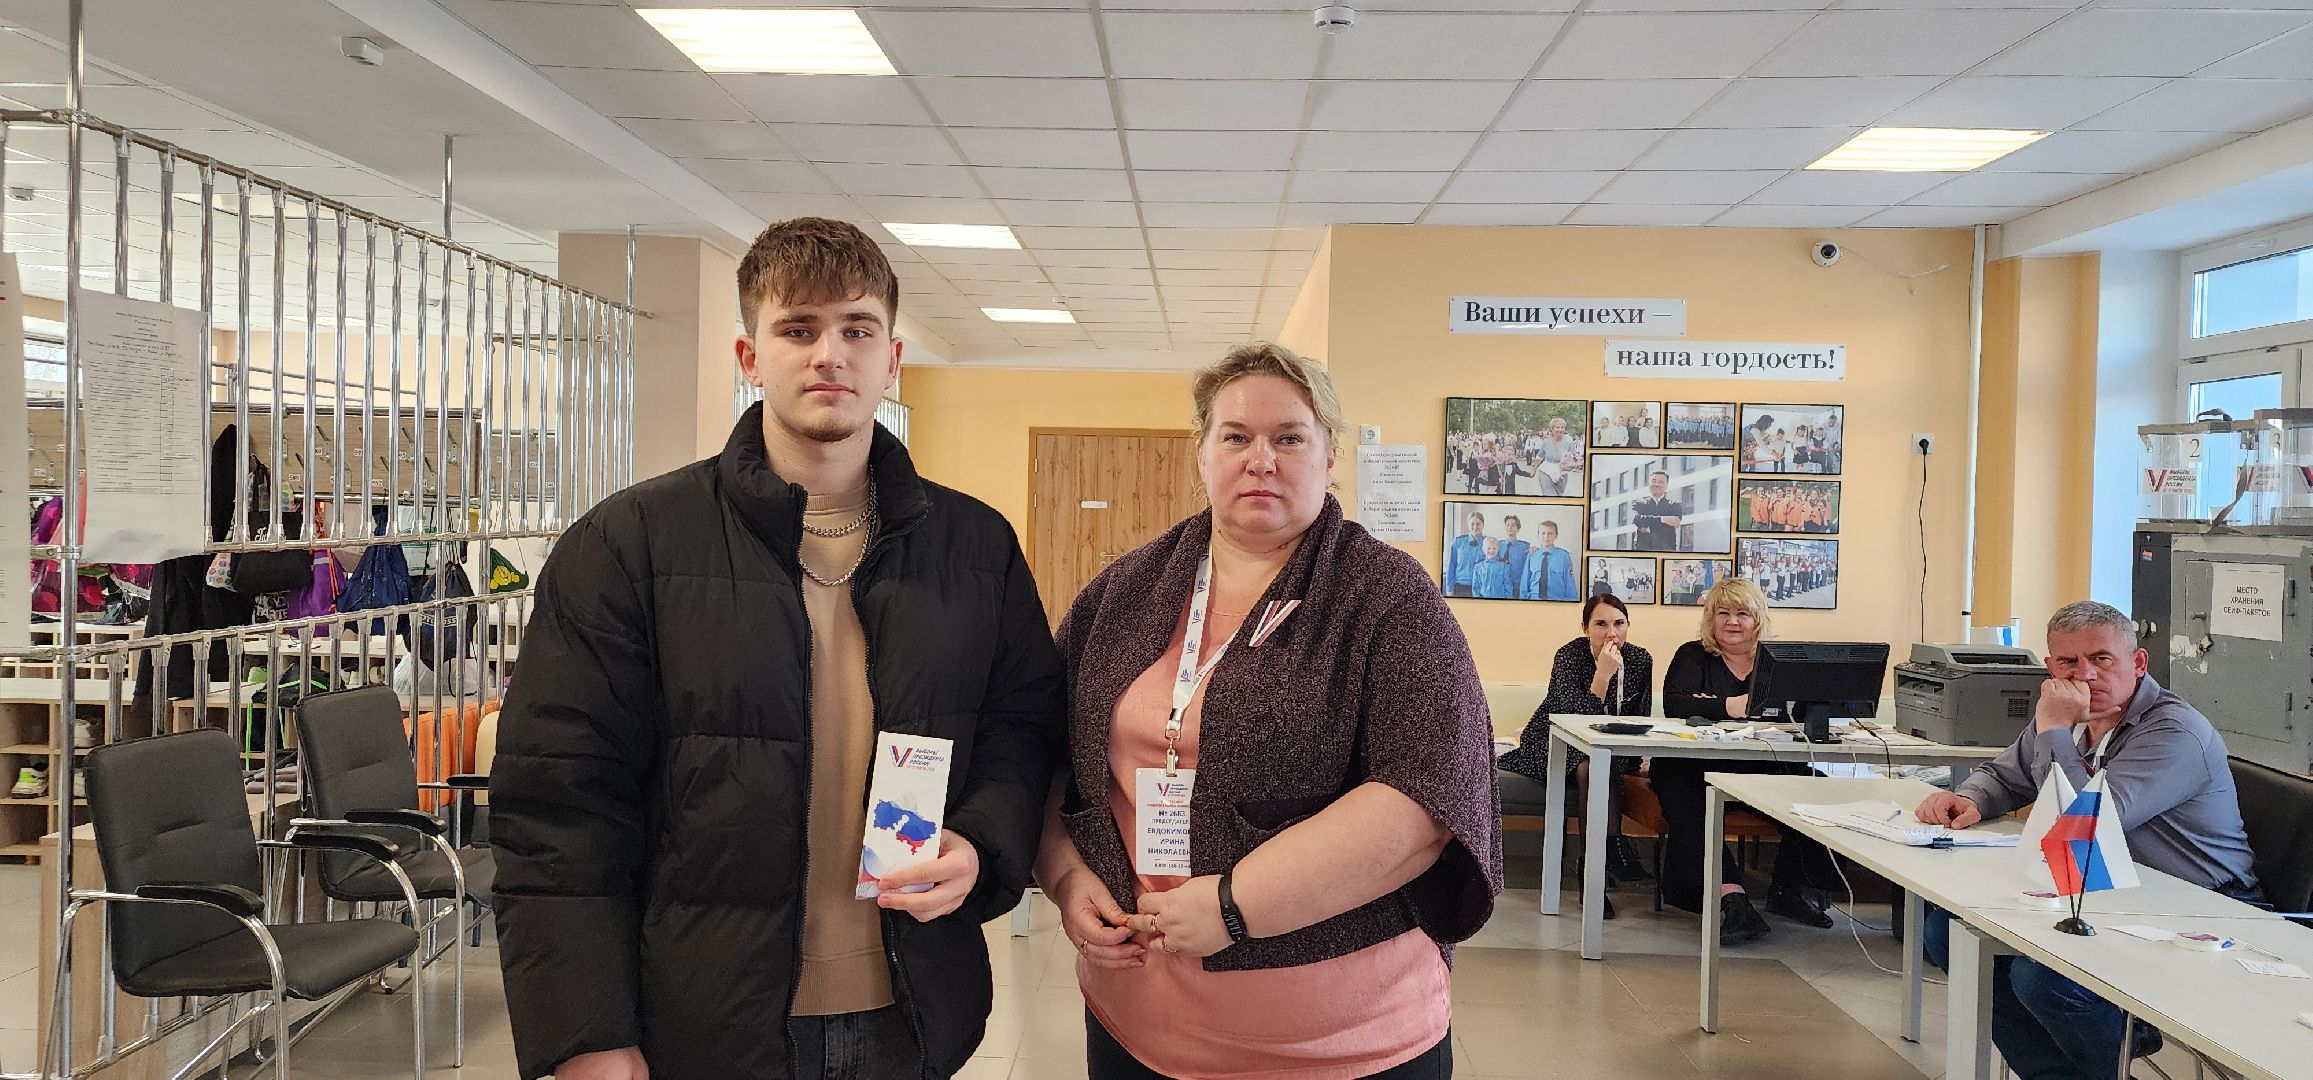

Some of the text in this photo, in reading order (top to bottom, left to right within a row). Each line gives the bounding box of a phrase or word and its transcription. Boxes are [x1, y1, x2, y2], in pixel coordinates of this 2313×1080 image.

[1464, 301, 1542, 323] Ваши
[1549, 306, 1646, 330] успехи
[1616, 349, 1836, 375] наша гордость!
[2189, 438, 2201, 458] 2
[2236, 586, 2259, 595] МЕСТО
[2230, 596, 2264, 606] ХРАНЕНИЯ
[2223, 606, 2271, 617] СЕЙФ-ПАКЕТОВ
[1160, 838, 1185, 846] ИРИНА
